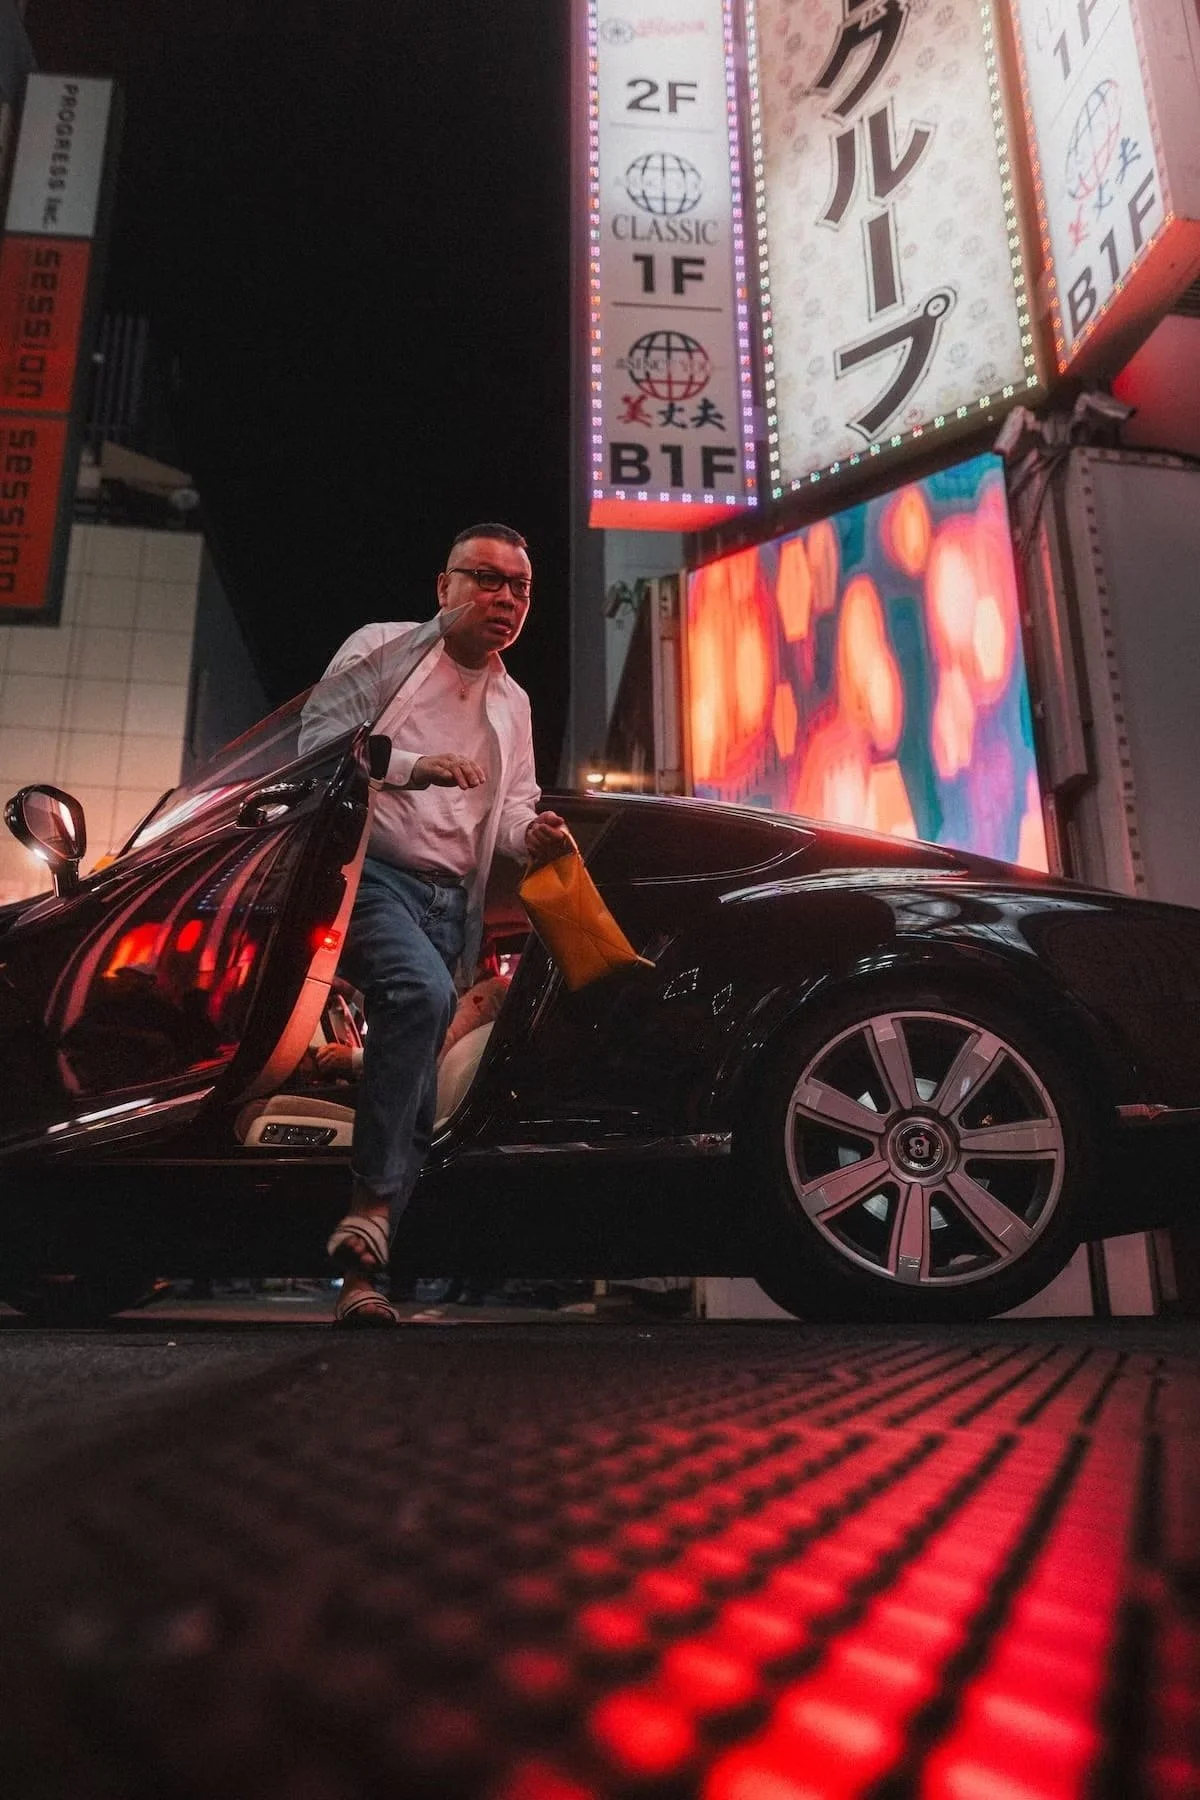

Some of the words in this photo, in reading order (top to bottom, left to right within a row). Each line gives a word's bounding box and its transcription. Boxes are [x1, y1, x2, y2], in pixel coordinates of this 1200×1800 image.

[626, 78, 698, 114] 2F
[48, 84, 80, 192] PROGRESS
[611, 213, 720, 245] CLASSIC
[633, 252, 706, 295] 1F
[1068, 168, 1155, 338] B1F
[16, 248, 60, 397] session
[609, 442, 737, 489] B1F
